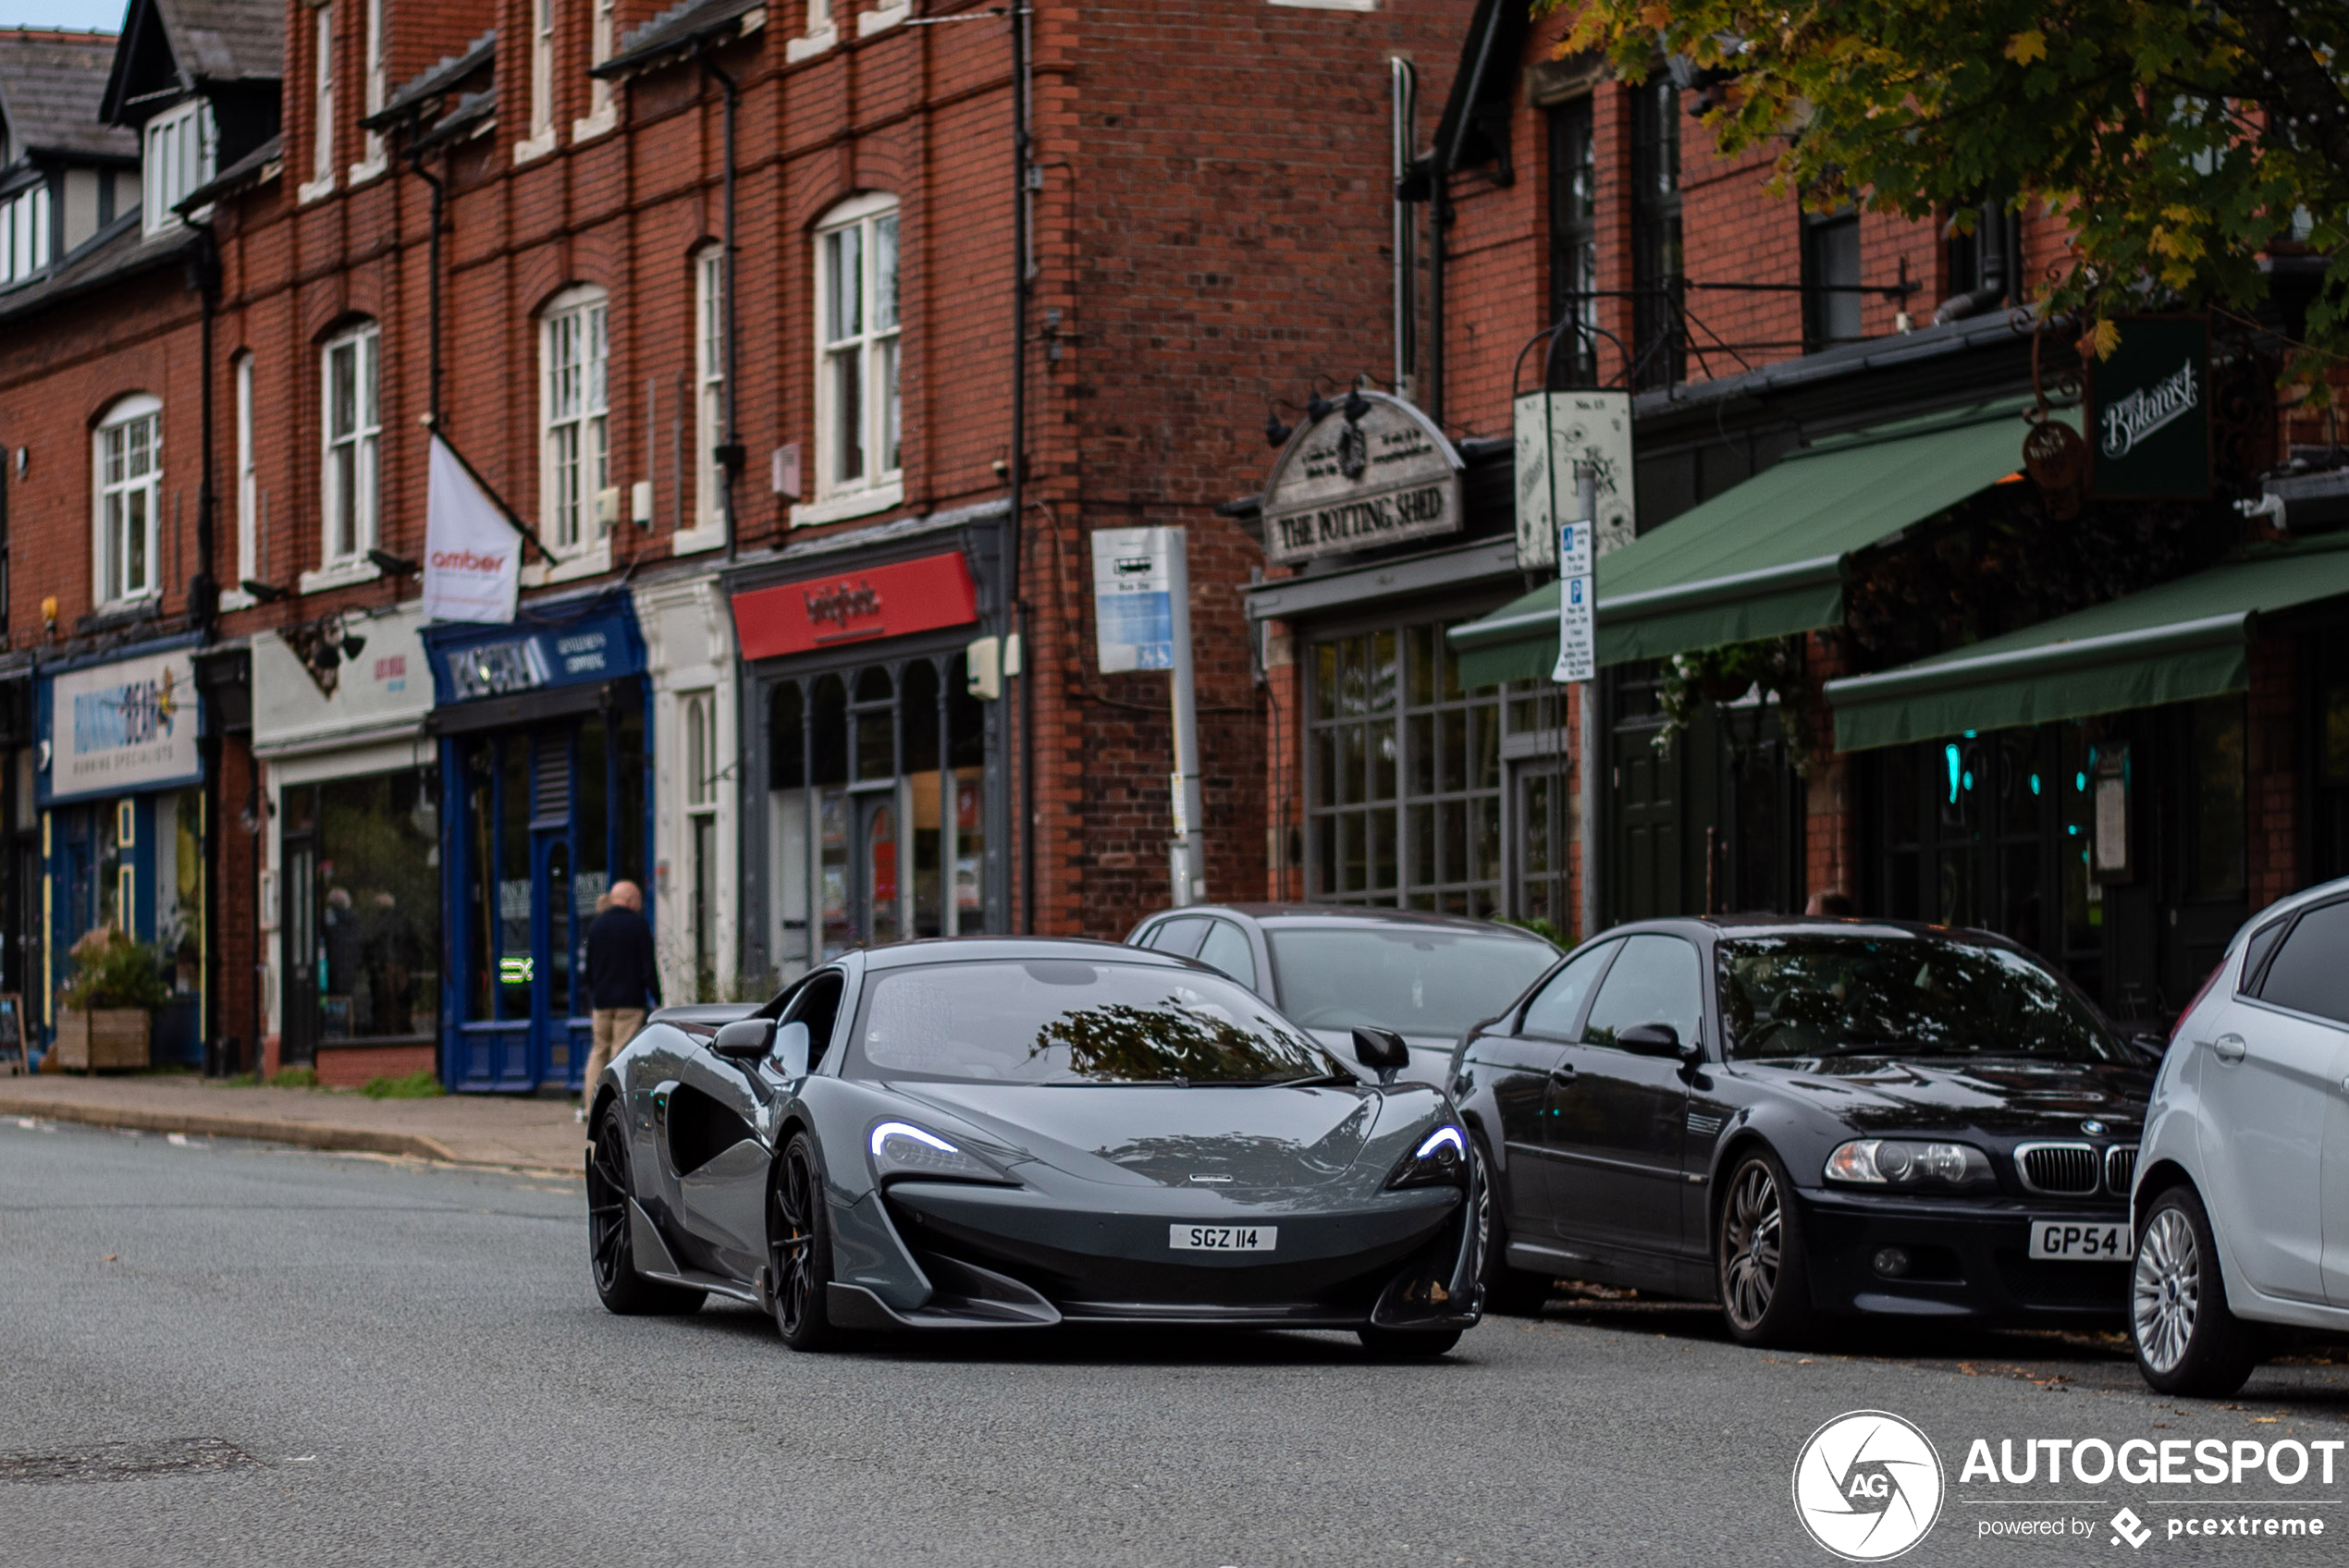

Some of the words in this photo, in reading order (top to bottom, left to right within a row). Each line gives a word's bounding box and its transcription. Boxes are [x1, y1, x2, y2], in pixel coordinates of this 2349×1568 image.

[2101, 357, 2198, 459] Botanist
[1280, 514, 1315, 550] THE
[1318, 497, 1392, 542] POTTING
[1396, 486, 1443, 526] SHED
[431, 549, 506, 572] amber
[1119, 582, 1134, 592] Bus
[1190, 1229, 1230, 1247] SGZ
[1236, 1230, 1258, 1248] 114
[2043, 1226, 2118, 1255] GP54
